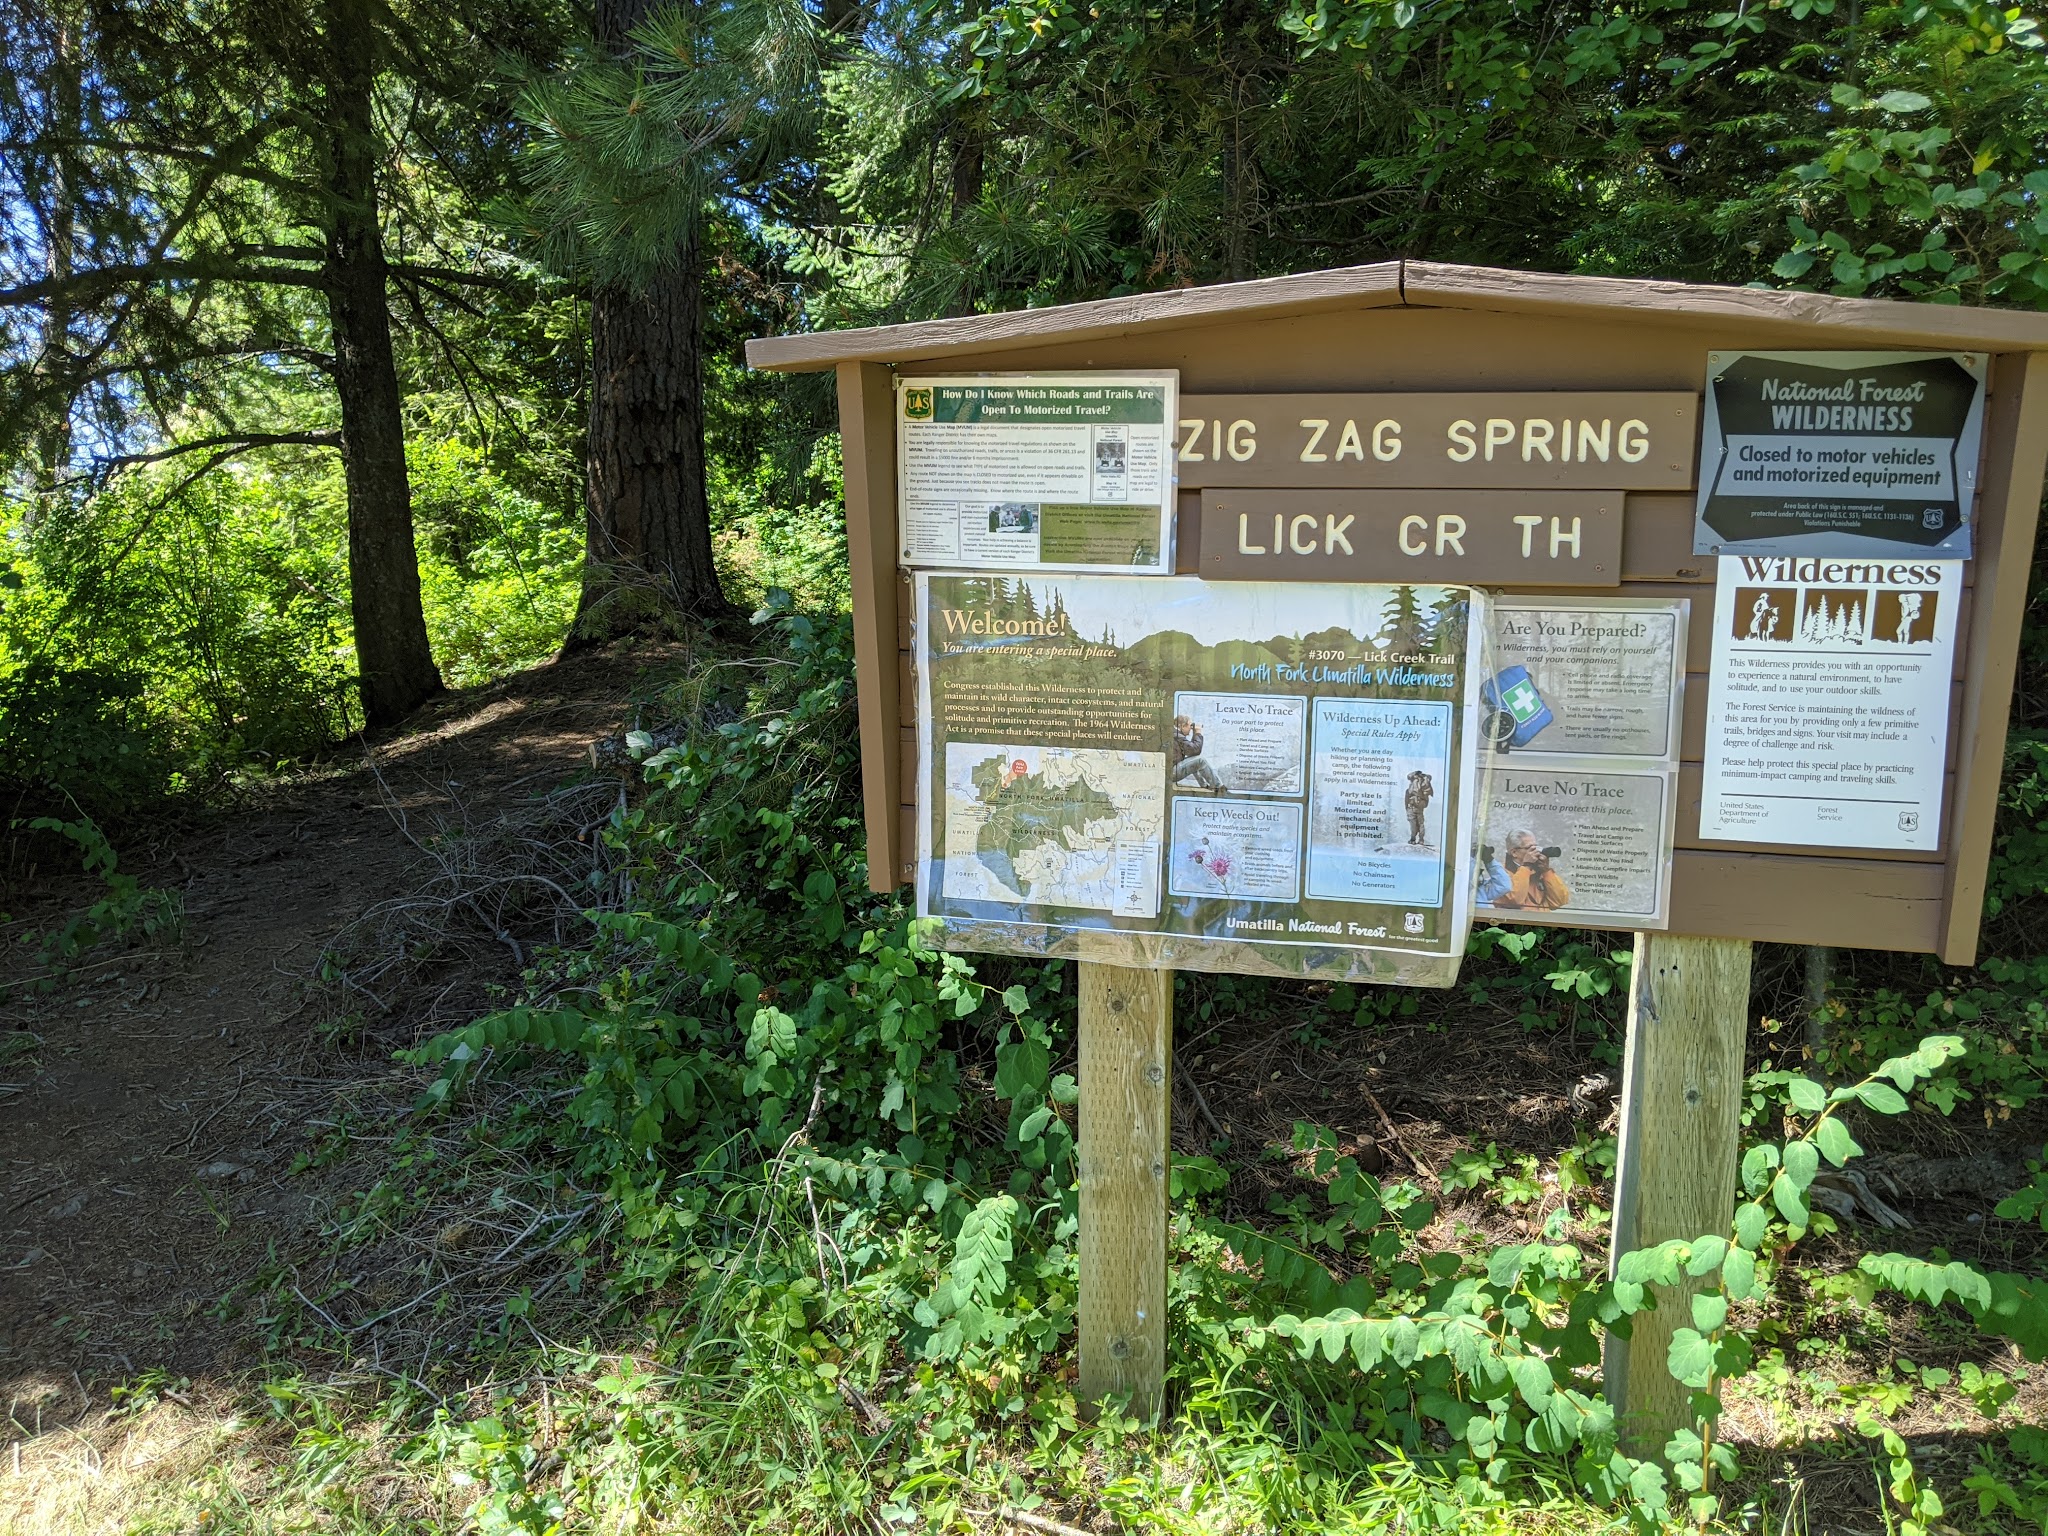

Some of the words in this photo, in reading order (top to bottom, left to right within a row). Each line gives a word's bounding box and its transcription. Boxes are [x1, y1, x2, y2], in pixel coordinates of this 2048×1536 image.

[943, 390, 962, 399] How
[966, 390, 978, 399] Do
[981, 390, 984, 398] I
[988, 390, 1014, 398] Know
[1017, 390, 1046, 398] Which
[1050, 390, 1080, 399] Roads
[1083, 390, 1102, 399] and
[1105, 390, 1133, 399] Trails
[1137, 390, 1154, 399] Are
[1762, 379, 1854, 402] National
[1859, 379, 1926, 402] Forest
[982, 405, 1006, 416] Open
[1009, 406, 1021, 414] To
[1024, 406, 1072, 414] Motorized
[1075, 406, 1111, 415] Travel?
[1772, 406, 1912, 431] WILDERNESS
[1178, 419, 1257, 461] ZIG
[1300, 419, 1402, 462] ZAG
[1447, 419, 1649, 462] SPRING
[1740, 446, 1791, 462] Closed
[1797, 449, 1813, 462] to
[1818, 449, 1867, 463] motor
[1872, 448, 1935, 465] vehicles
[1734, 466, 1764, 481] and
[1767, 467, 1850, 483] motorized
[1853, 468, 1941, 488] equipment
[1239, 514, 1355, 555] LICK
[1399, 515, 1467, 556] CR
[1513, 516, 1581, 559] TH
[1740, 556, 1940, 584] Wilderness
[942, 610, 1066, 636] Welcome!
[1503, 621, 1531, 635] Are
[1536, 621, 1565, 635] You
[1571, 622, 1647, 640] Prepared?
[942, 642, 964, 653] You
[966, 645, 984, 653] are
[985, 644, 1033, 658] entering
[1036, 648, 1043, 656] a
[1045, 645, 1083, 659] special
[1084, 647, 1117, 660] place.
[1309, 650, 1345, 660] #3070
[1365, 651, 1387, 662] Lick
[1391, 653, 1425, 663] Creek
[1429, 654, 1454, 664] Trail
[1503, 643, 1549, 653] Wilderness,
[1592, 646, 1608, 655] rely
[1610, 646, 1622, 654] on
[1624, 647, 1657, 656] yourself
[1527, 655, 1543, 663] and
[1567, 657, 1619, 666] companions.
[1729, 659, 1745, 667] This
[1748, 660, 1790, 668] Wilderness
[1792, 661, 1826, 670] provides
[1845, 662, 1861, 670] with
[1876, 664, 1922, 674] opportunity
[1232, 664, 1270, 682] North
[1276, 664, 1306, 682] Fork
[1311, 665, 1371, 684] Umatilla
[1376, 669, 1454, 688] Wilderness
[1738, 672, 1780, 681] experience
[1790, 673, 1817, 681] natural
[1820, 674, 1871, 684] environment,
[1885, 675, 1902, 683] have
[944, 681, 980, 691] Congress
[982, 682, 1023, 691] established
[1042, 684, 1086, 693] Wilderness
[1216, 703, 1245, 714] Leave
[1248, 705, 1263, 714] No
[1266, 706, 1292, 716] Trace
[1323, 712, 1381, 724] Wilderness
[1385, 715, 1400, 726] Up
[1403, 716, 1440, 726] Ahead:
[1342, 728, 1370, 739] Special
[1372, 730, 1394, 738] Rules
[1396, 731, 1421, 742] Apply
[1722, 758, 1746, 766] Please
[1748, 758, 1764, 769] help
[1767, 761, 1794, 769] protect
[1796, 760, 1810, 768] this
[1812, 762, 1838, 771] special
[1841, 762, 1862, 772] place
[1864, 763, 1873, 773] by
[1875, 765, 1914, 775] practicing
[1506, 779, 1549, 794] Leave
[1554, 781, 1577, 795] No
[1582, 783, 1624, 797] Trace
[1194, 808, 1220, 819] Keep
[1222, 809, 1253, 820] Weeds
[1256, 811, 1280, 821] Out!
[1529, 804, 1547, 812] part
[1592, 806, 1606, 814] this
[1608, 807, 1633, 816] place.
[1720, 809, 1760, 817] Department
[1227, 918, 1284, 932] Umatilla
[1289, 919, 1342, 934] National
[1348, 923, 1387, 938] Forest
